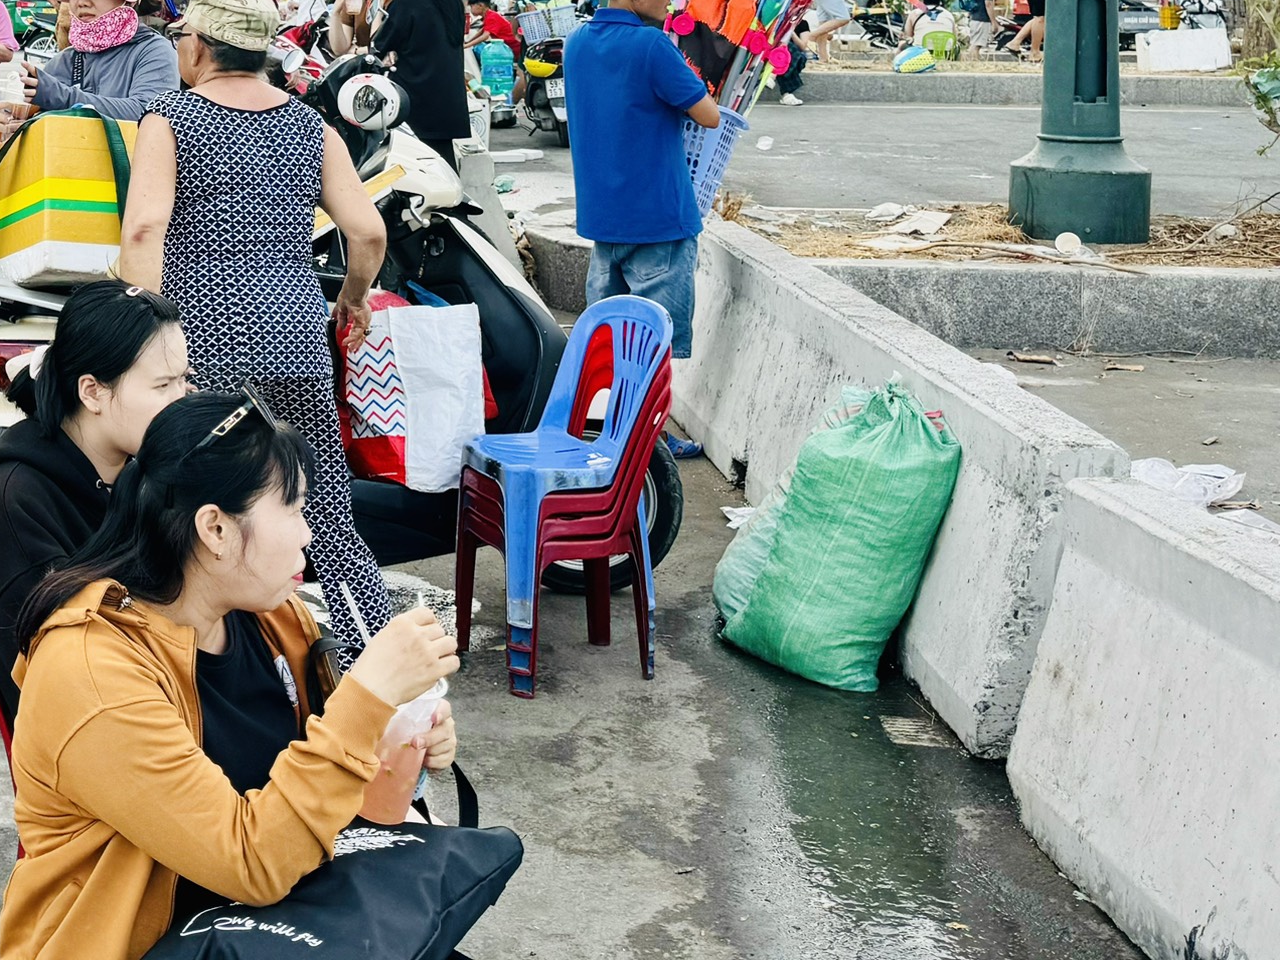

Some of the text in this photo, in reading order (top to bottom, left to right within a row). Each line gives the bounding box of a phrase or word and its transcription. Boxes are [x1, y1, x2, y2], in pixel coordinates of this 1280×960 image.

[231, 915, 324, 948] We will fly
